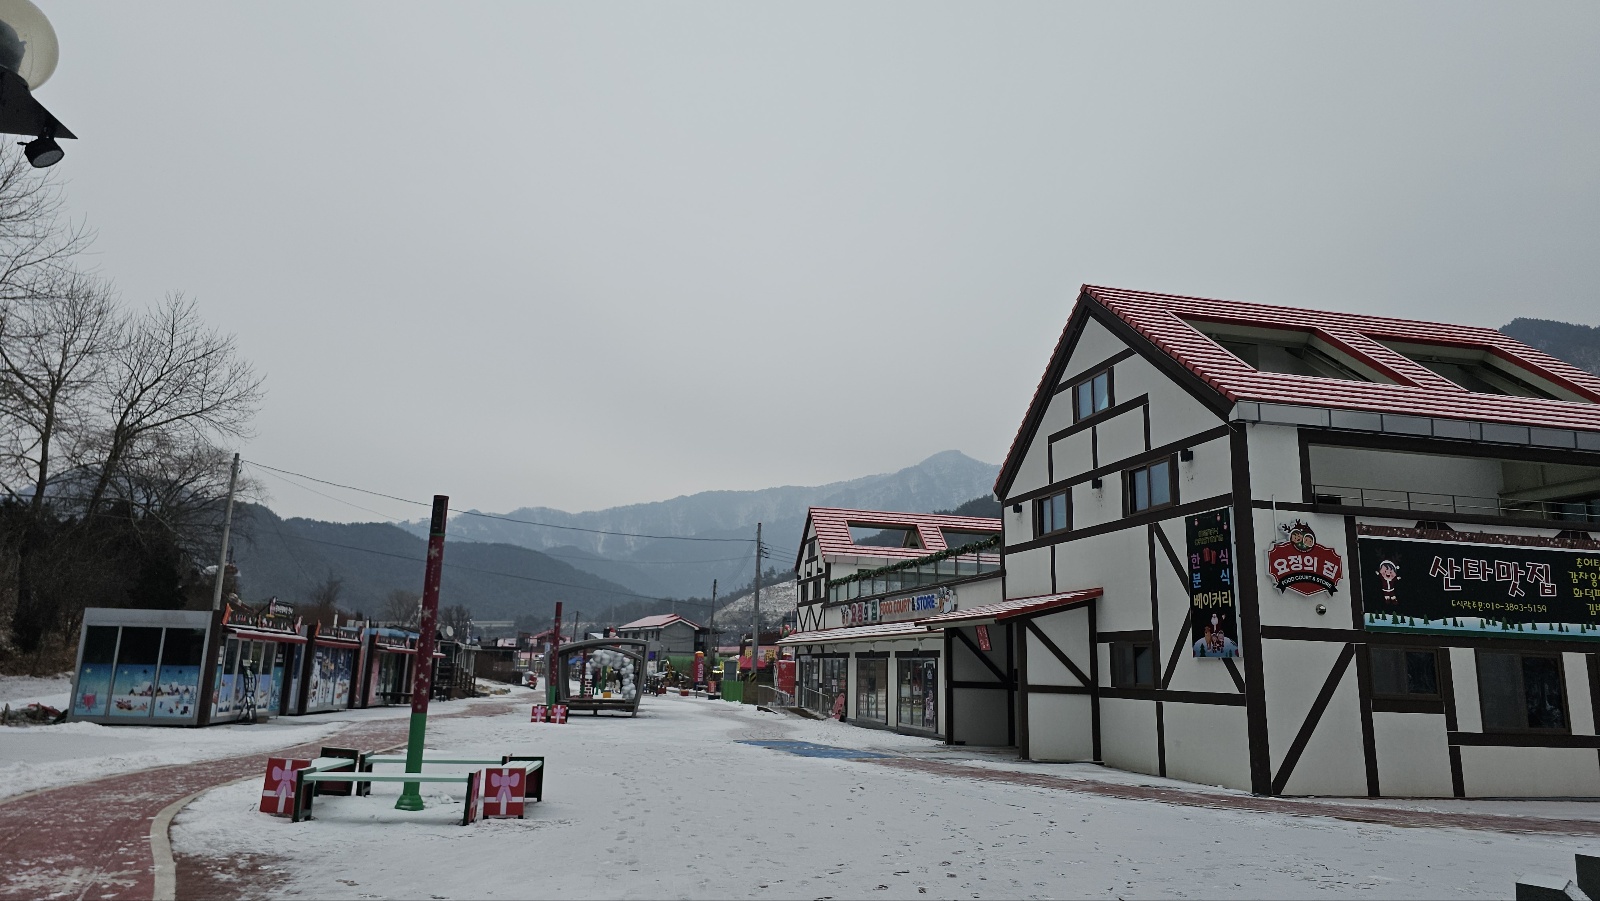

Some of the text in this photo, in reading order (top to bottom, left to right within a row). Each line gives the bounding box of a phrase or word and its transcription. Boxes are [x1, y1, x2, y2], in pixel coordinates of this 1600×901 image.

[1191, 548, 1228, 569] 한 식
[1274, 555, 1338, 579] 요정의 집
[1192, 568, 1230, 588] 분 식
[1281, 576, 1295, 585] FOOD
[1316, 577, 1333, 588] STORE
[1429, 555, 1557, 597] 산타맛집
[1569, 571, 1600, 587] 감자옹
[880, 601, 893, 615] FOOD
[894, 598, 911, 614] COURT
[917, 595, 935, 610] STORE
[1193, 589, 1231, 609] 베이커리
